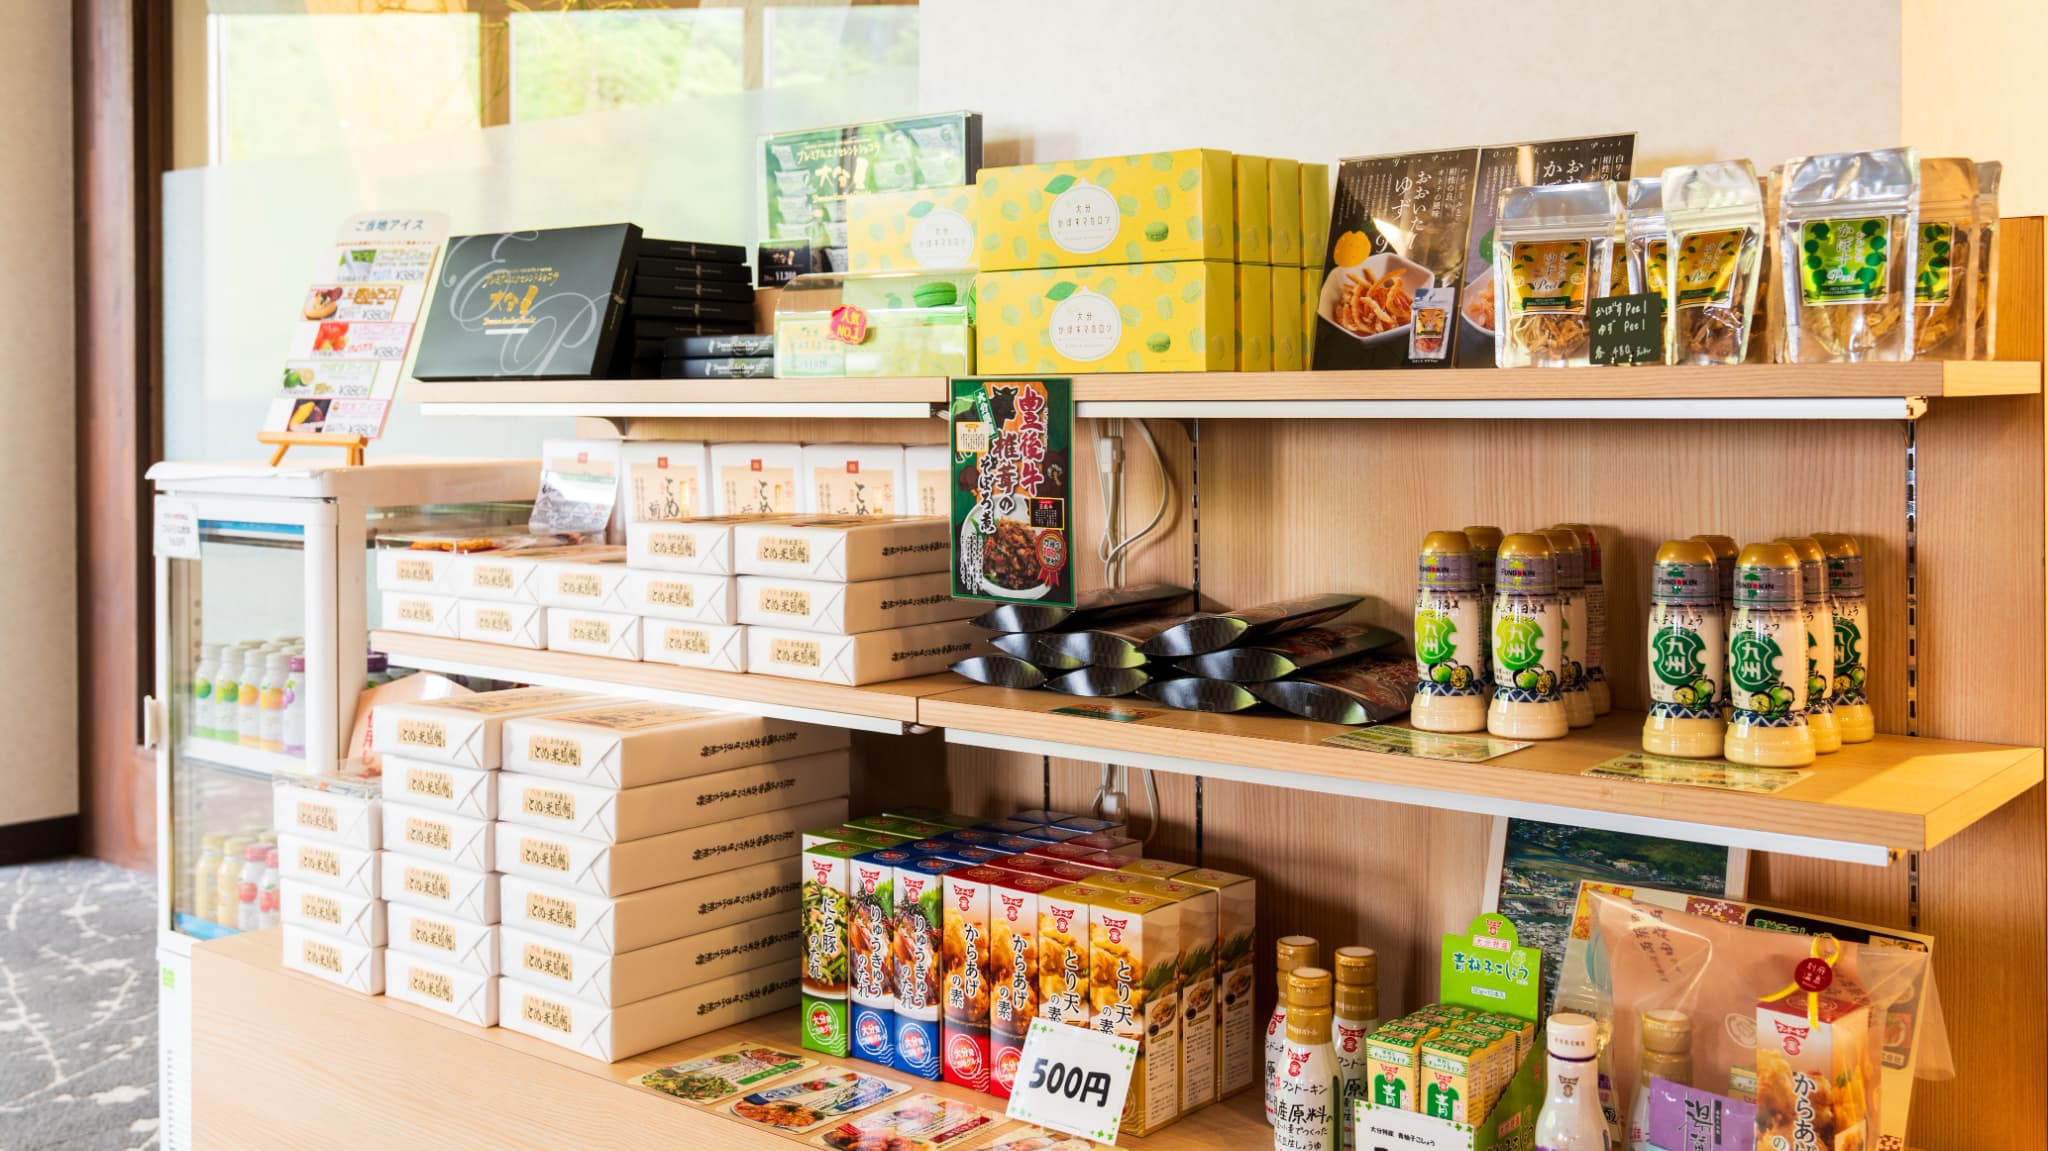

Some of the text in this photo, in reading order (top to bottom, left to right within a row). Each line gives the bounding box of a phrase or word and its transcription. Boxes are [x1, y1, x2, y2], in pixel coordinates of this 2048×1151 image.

[1543, 161, 1563, 185] か
[1391, 176, 1413, 221] ゆず
[1410, 170, 1432, 231] おおいた
[354, 219, 425, 232] ご当地アイス
[841, 309, 861, 323] 人気
[1624, 318, 1646, 333] Peel
[1625, 299, 1647, 317] Peel
[836, 324, 860, 339] NO.1
[1019, 385, 1045, 496] 豊後牛
[992, 432, 1018, 513] 椎茸の
[1424, 622, 1439, 656] 九州
[1508, 625, 1526, 661] 九州
[1665, 637, 1688, 674] 九州
[1741, 644, 1761, 680] 九州
[822, 896, 837, 953] にら豚
[808, 933, 823, 979] のたれ
[870, 905, 883, 999] りゅうきゅう
[915, 914, 928, 1010] りゅうきゅう
[965, 925, 979, 997] からあげ
[1453, 951, 1529, 982] 青柚子こしょう
[858, 954, 869, 998] のたれ
[901, 965, 913, 1010] のたれ
[1013, 936, 1028, 1009] からあげ
[1063, 949, 1080, 1014] とり天
[950, 975, 964, 1008] の素
[998, 987, 1012, 1021] の素
[1048, 994, 1062, 1022] の素
[1115, 960, 1133, 1026] とり天
[1100, 1006, 1114, 1035] の素
[1028, 1057, 1112, 1108] 500円
[1282, 1080, 1328, 1096] フンドーキン
[1398, 1132, 1436, 1147] 青柚子こしょう
